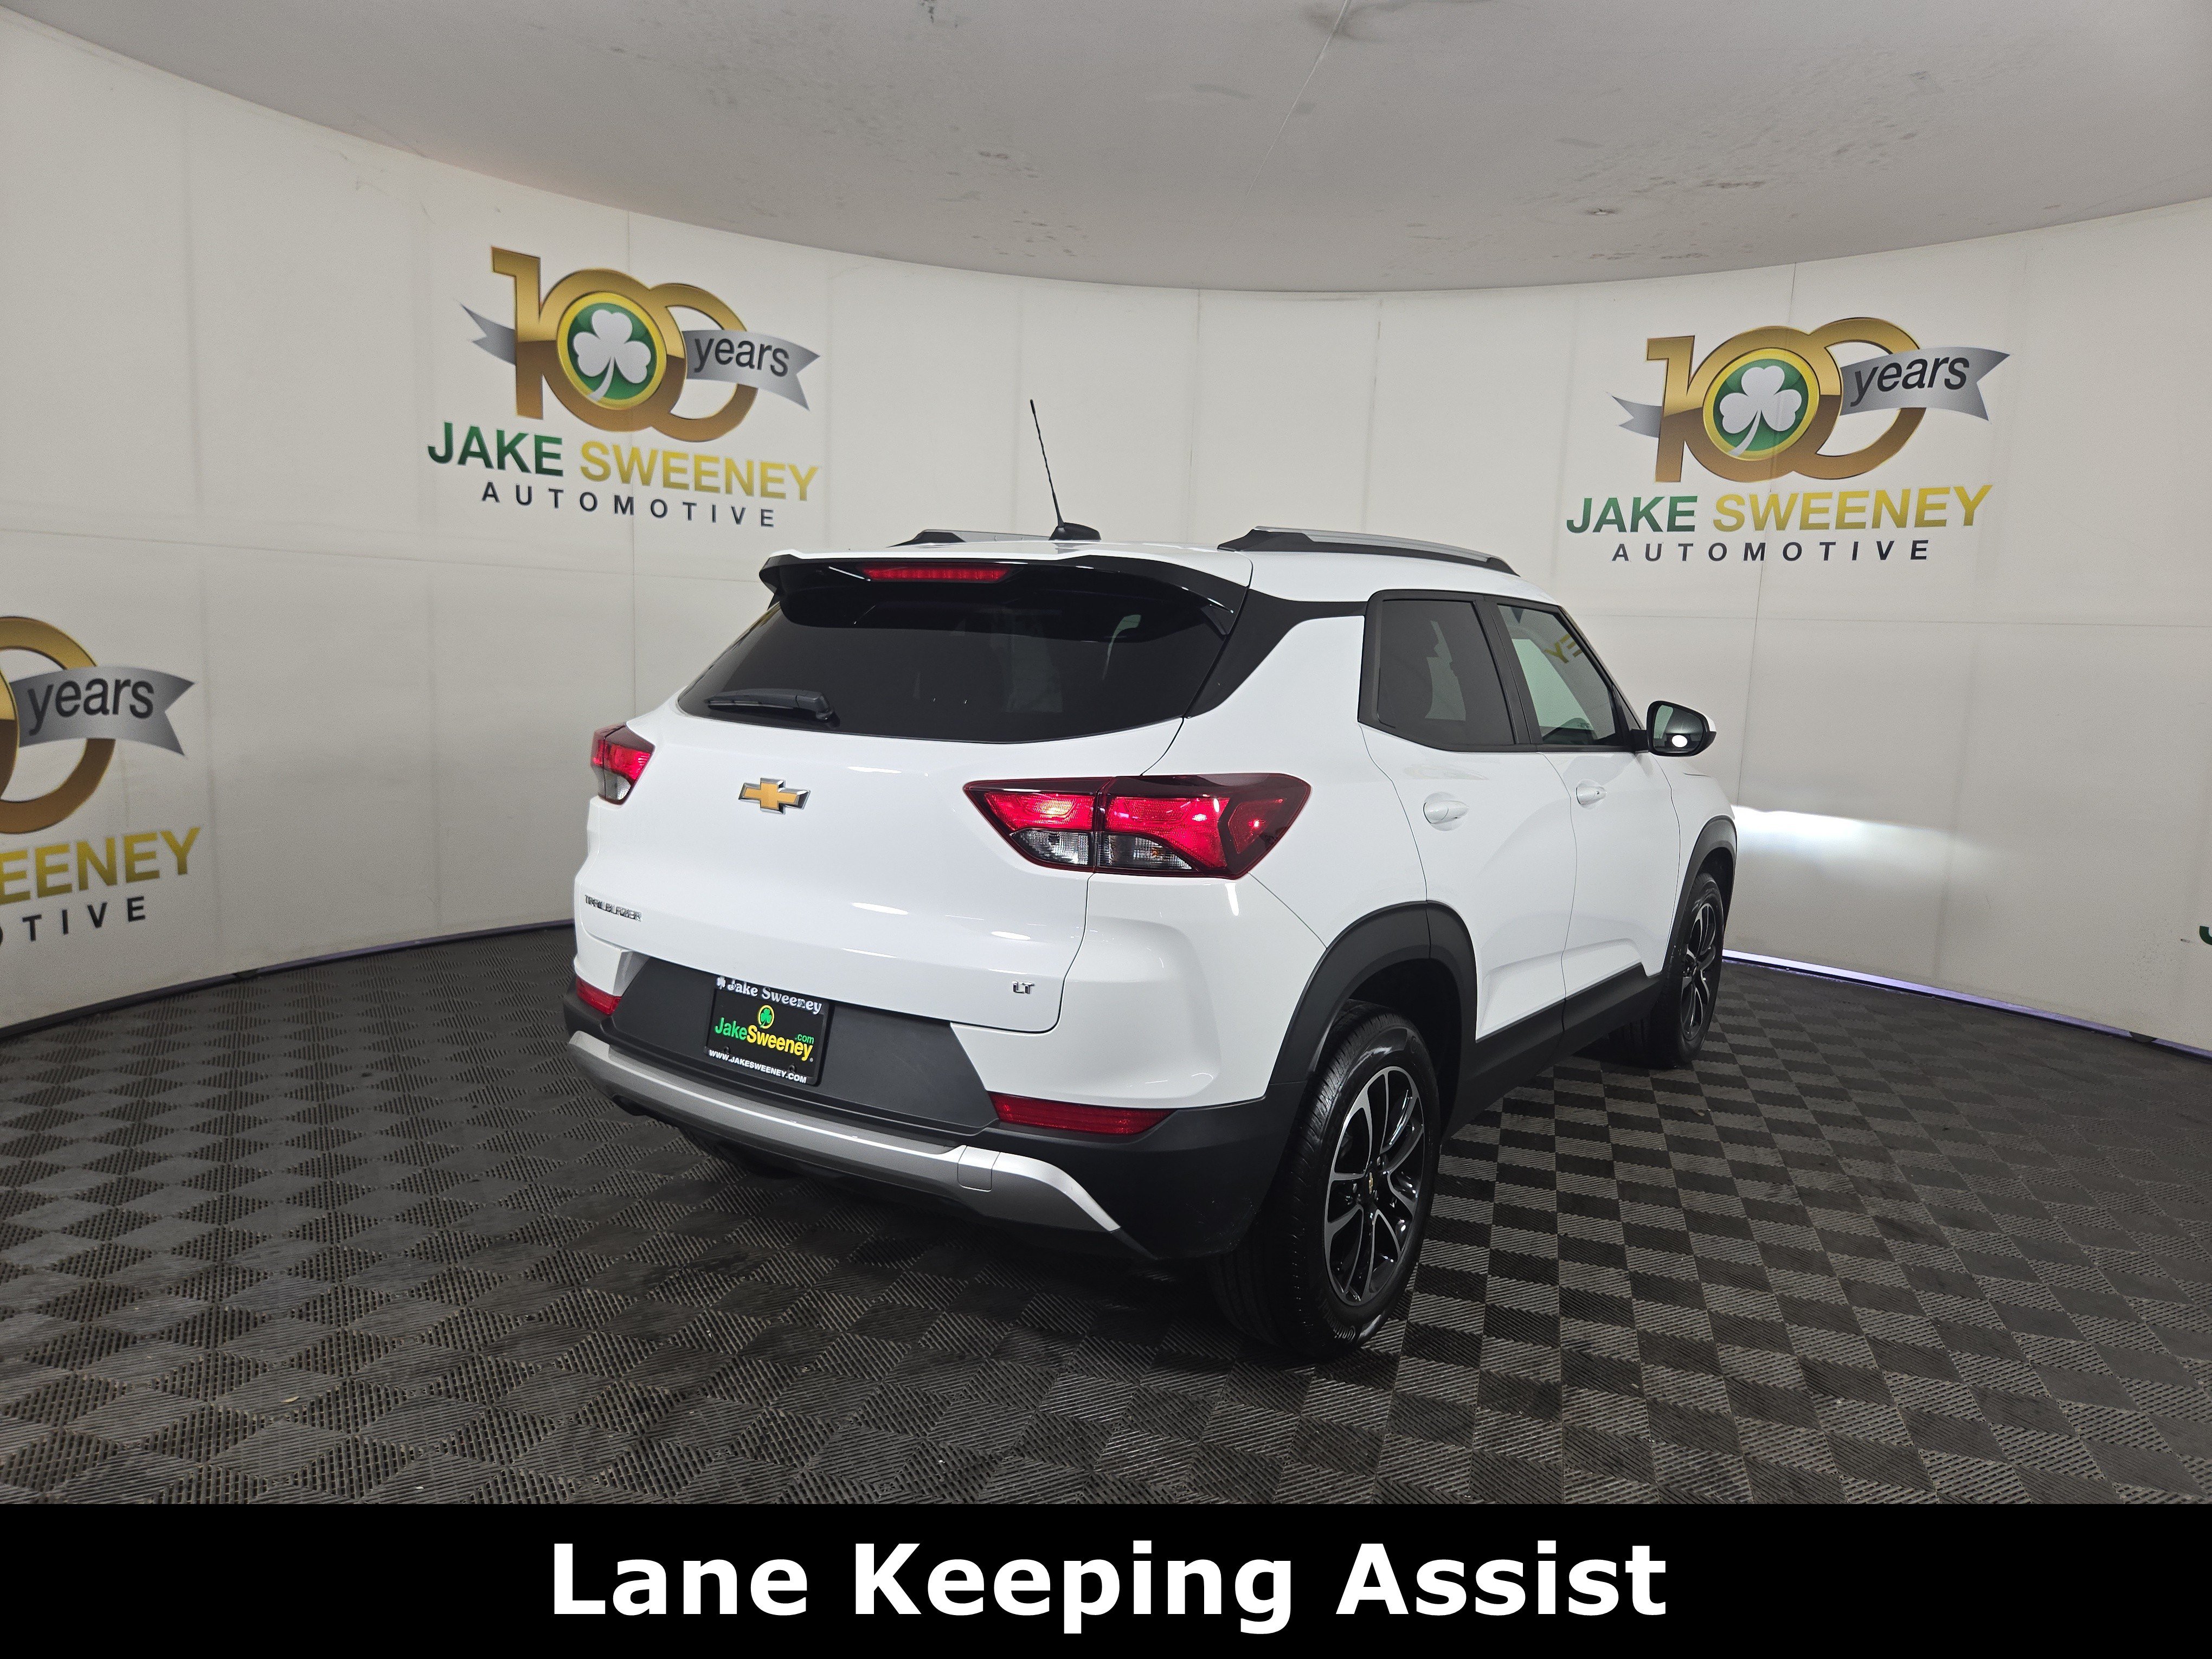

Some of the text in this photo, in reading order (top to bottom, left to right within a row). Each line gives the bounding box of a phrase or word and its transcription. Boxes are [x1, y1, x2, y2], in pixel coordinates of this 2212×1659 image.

[491, 246, 789, 442] 100 years
[1647, 317, 1970, 483] 100 years
[428, 421, 819, 501] JAKE SWEENEY
[481, 481, 775, 528] AUTOMOTIVE
[1566, 484, 1993, 533] JAKE SWEENEY
[1612, 539, 1929, 562] AUTOMOTIVE
[27, 677, 155, 736] years
[0, 826, 201, 905] EENEY
[0, 896, 146, 946] TIVE
[728, 978, 822, 1015] Jake Sweeney
[1012, 981, 1035, 994] LT
[709, 1049, 807, 1084] WWW.JAKESWEENEY.COM
